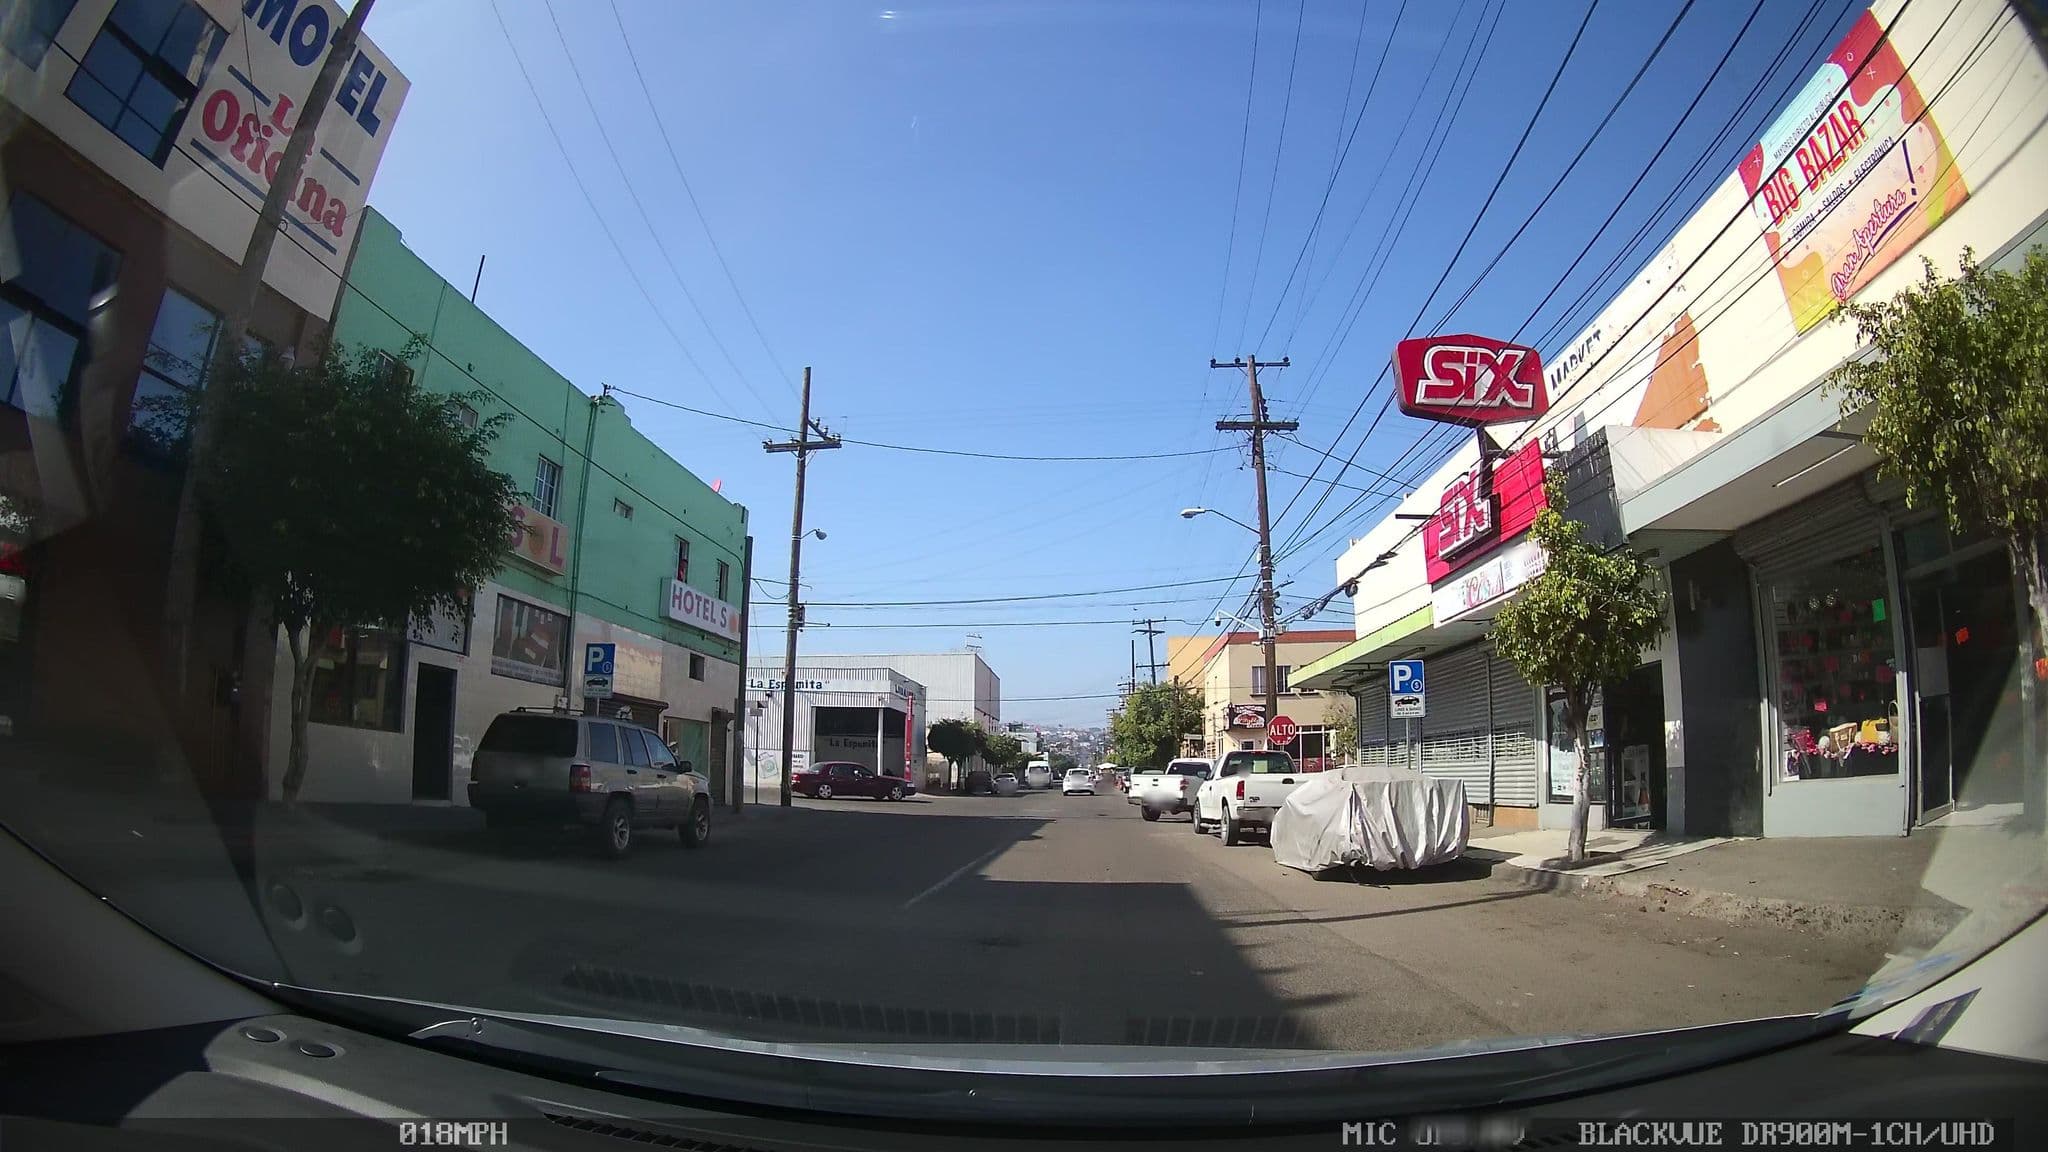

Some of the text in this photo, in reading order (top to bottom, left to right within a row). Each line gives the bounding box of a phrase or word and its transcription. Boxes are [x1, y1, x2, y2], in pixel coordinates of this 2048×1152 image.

[1762, 100, 1869, 229] BIG BAZAR
[671, 583, 717, 625] HOTEL
[587, 646, 604, 672] P
[1393, 664, 1412, 691] P
[1270, 724, 1295, 736] ALTO
